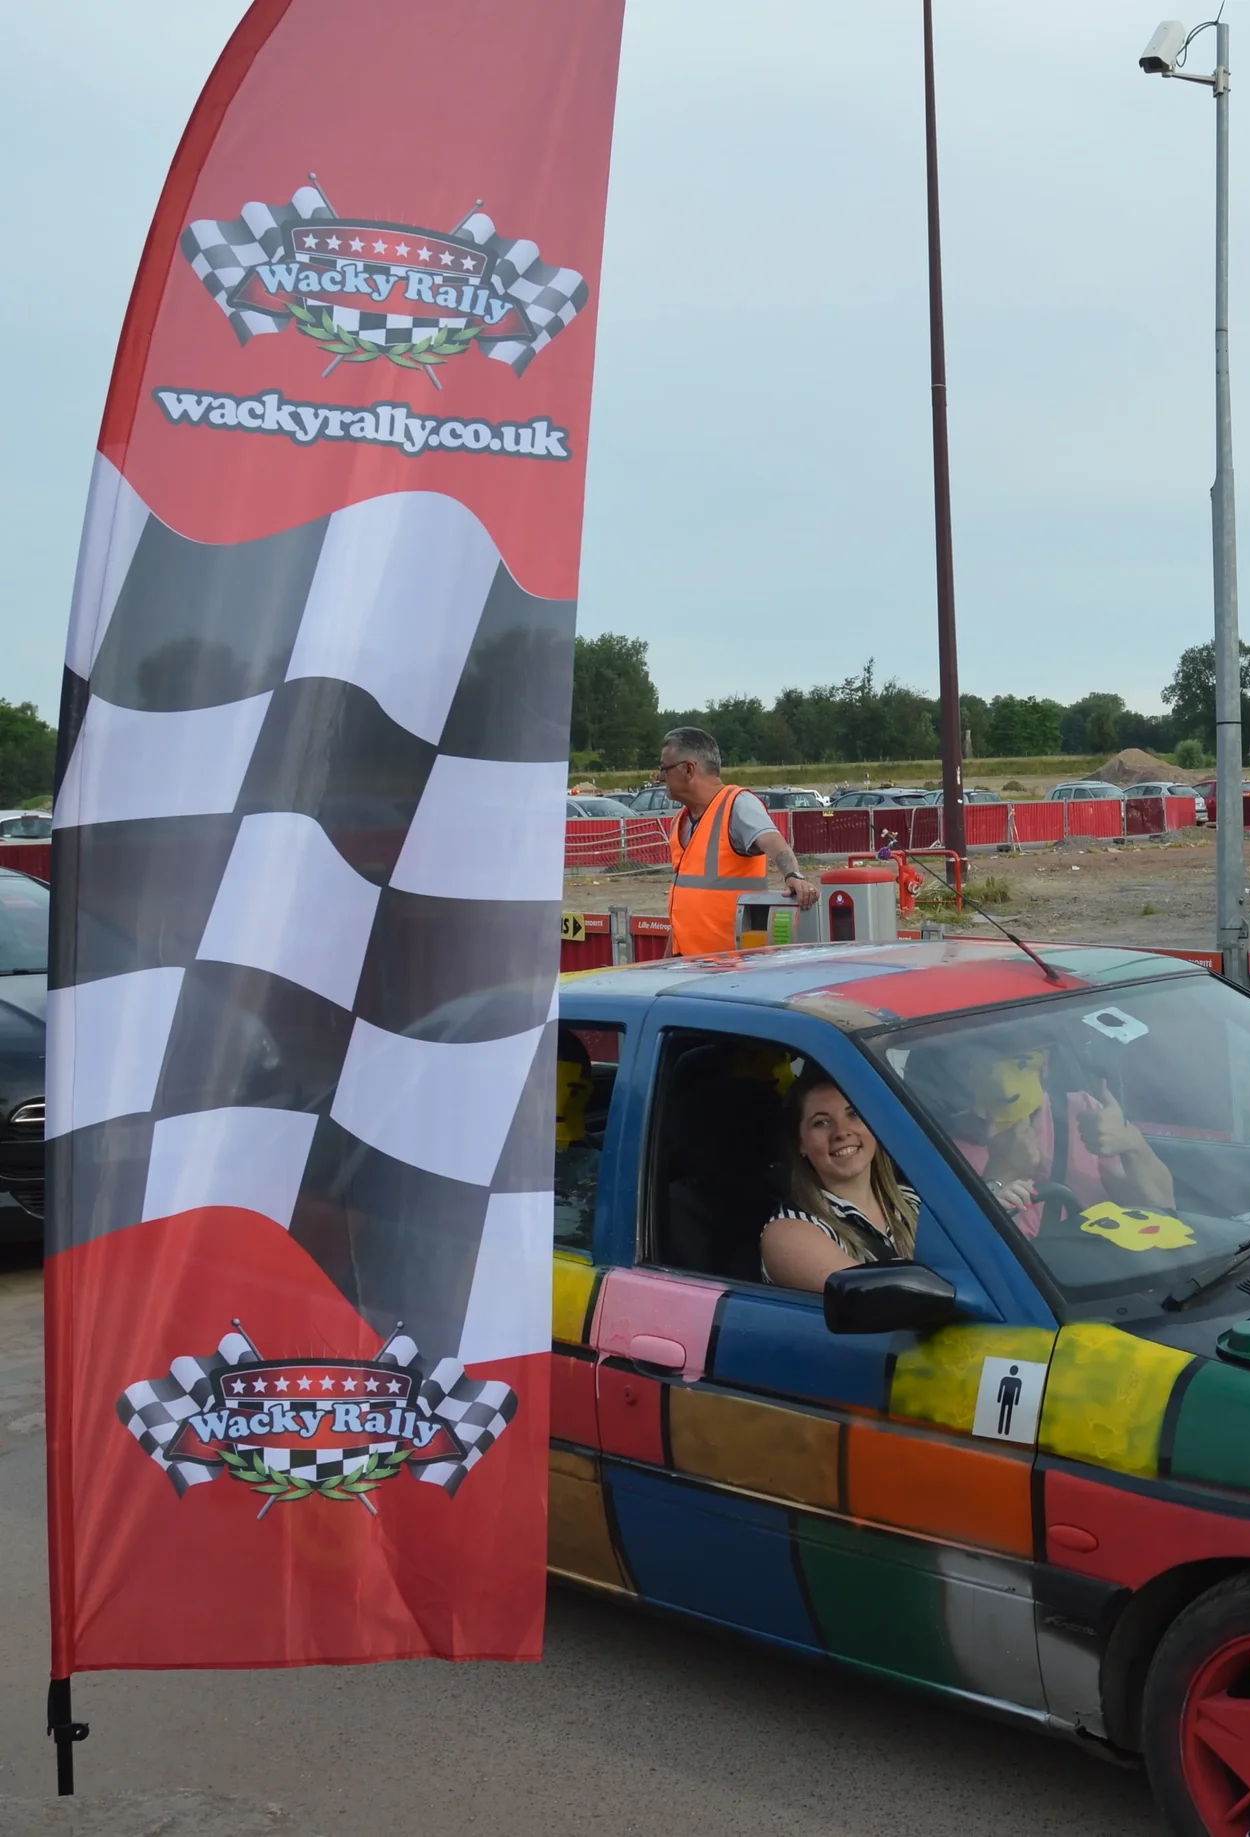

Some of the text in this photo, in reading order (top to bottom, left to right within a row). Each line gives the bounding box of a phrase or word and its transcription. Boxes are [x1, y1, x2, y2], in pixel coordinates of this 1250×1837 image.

[256, 261, 513, 324] Wacky Rally
[157, 390, 569, 458] wackyrally.co.uk
[650, 922, 672, 931] Métrop
[188, 1402, 442, 1447] Wacky Rally
